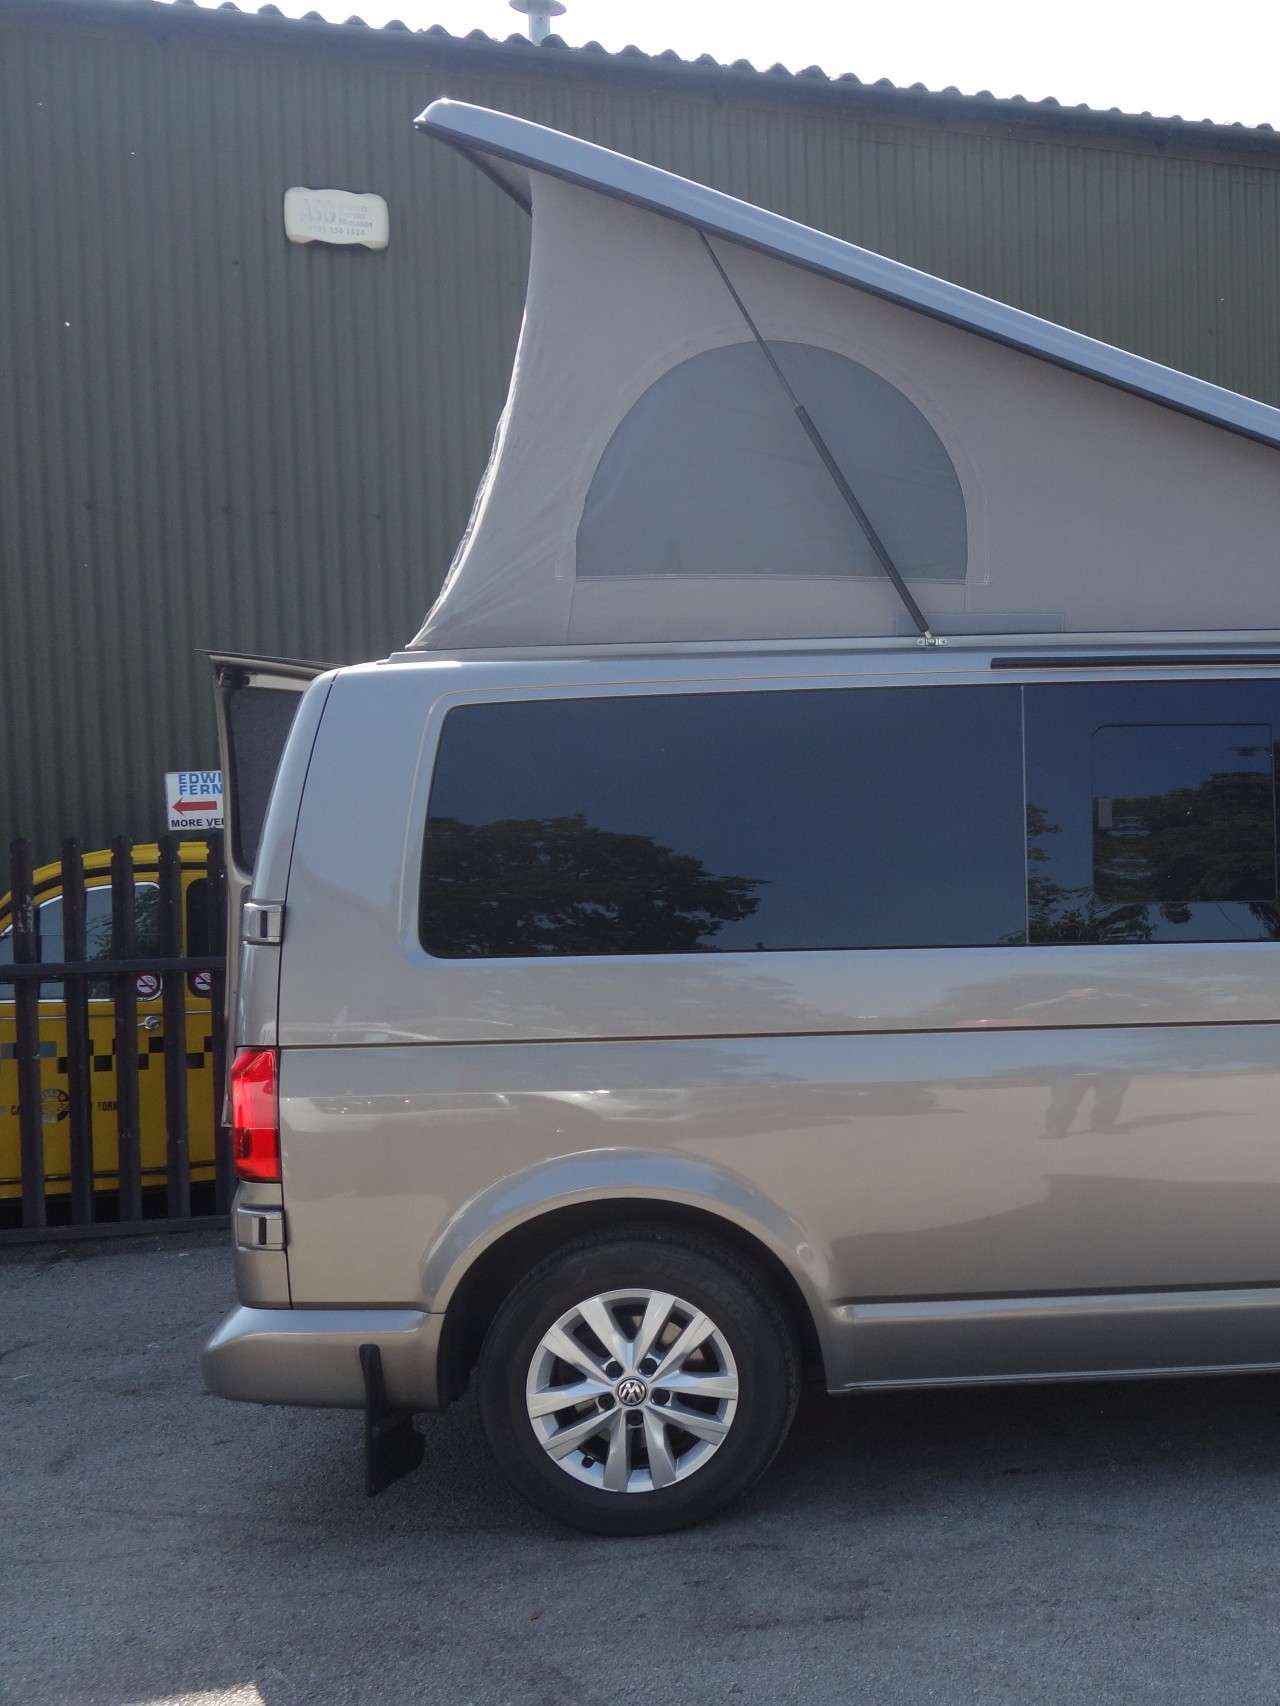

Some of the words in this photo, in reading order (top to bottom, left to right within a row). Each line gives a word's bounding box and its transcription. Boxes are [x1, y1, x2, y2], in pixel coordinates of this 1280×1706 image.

[178, 772, 223, 785] EDWI
[178, 783, 223, 796] FERN
[171, 818, 202, 828] MORE
